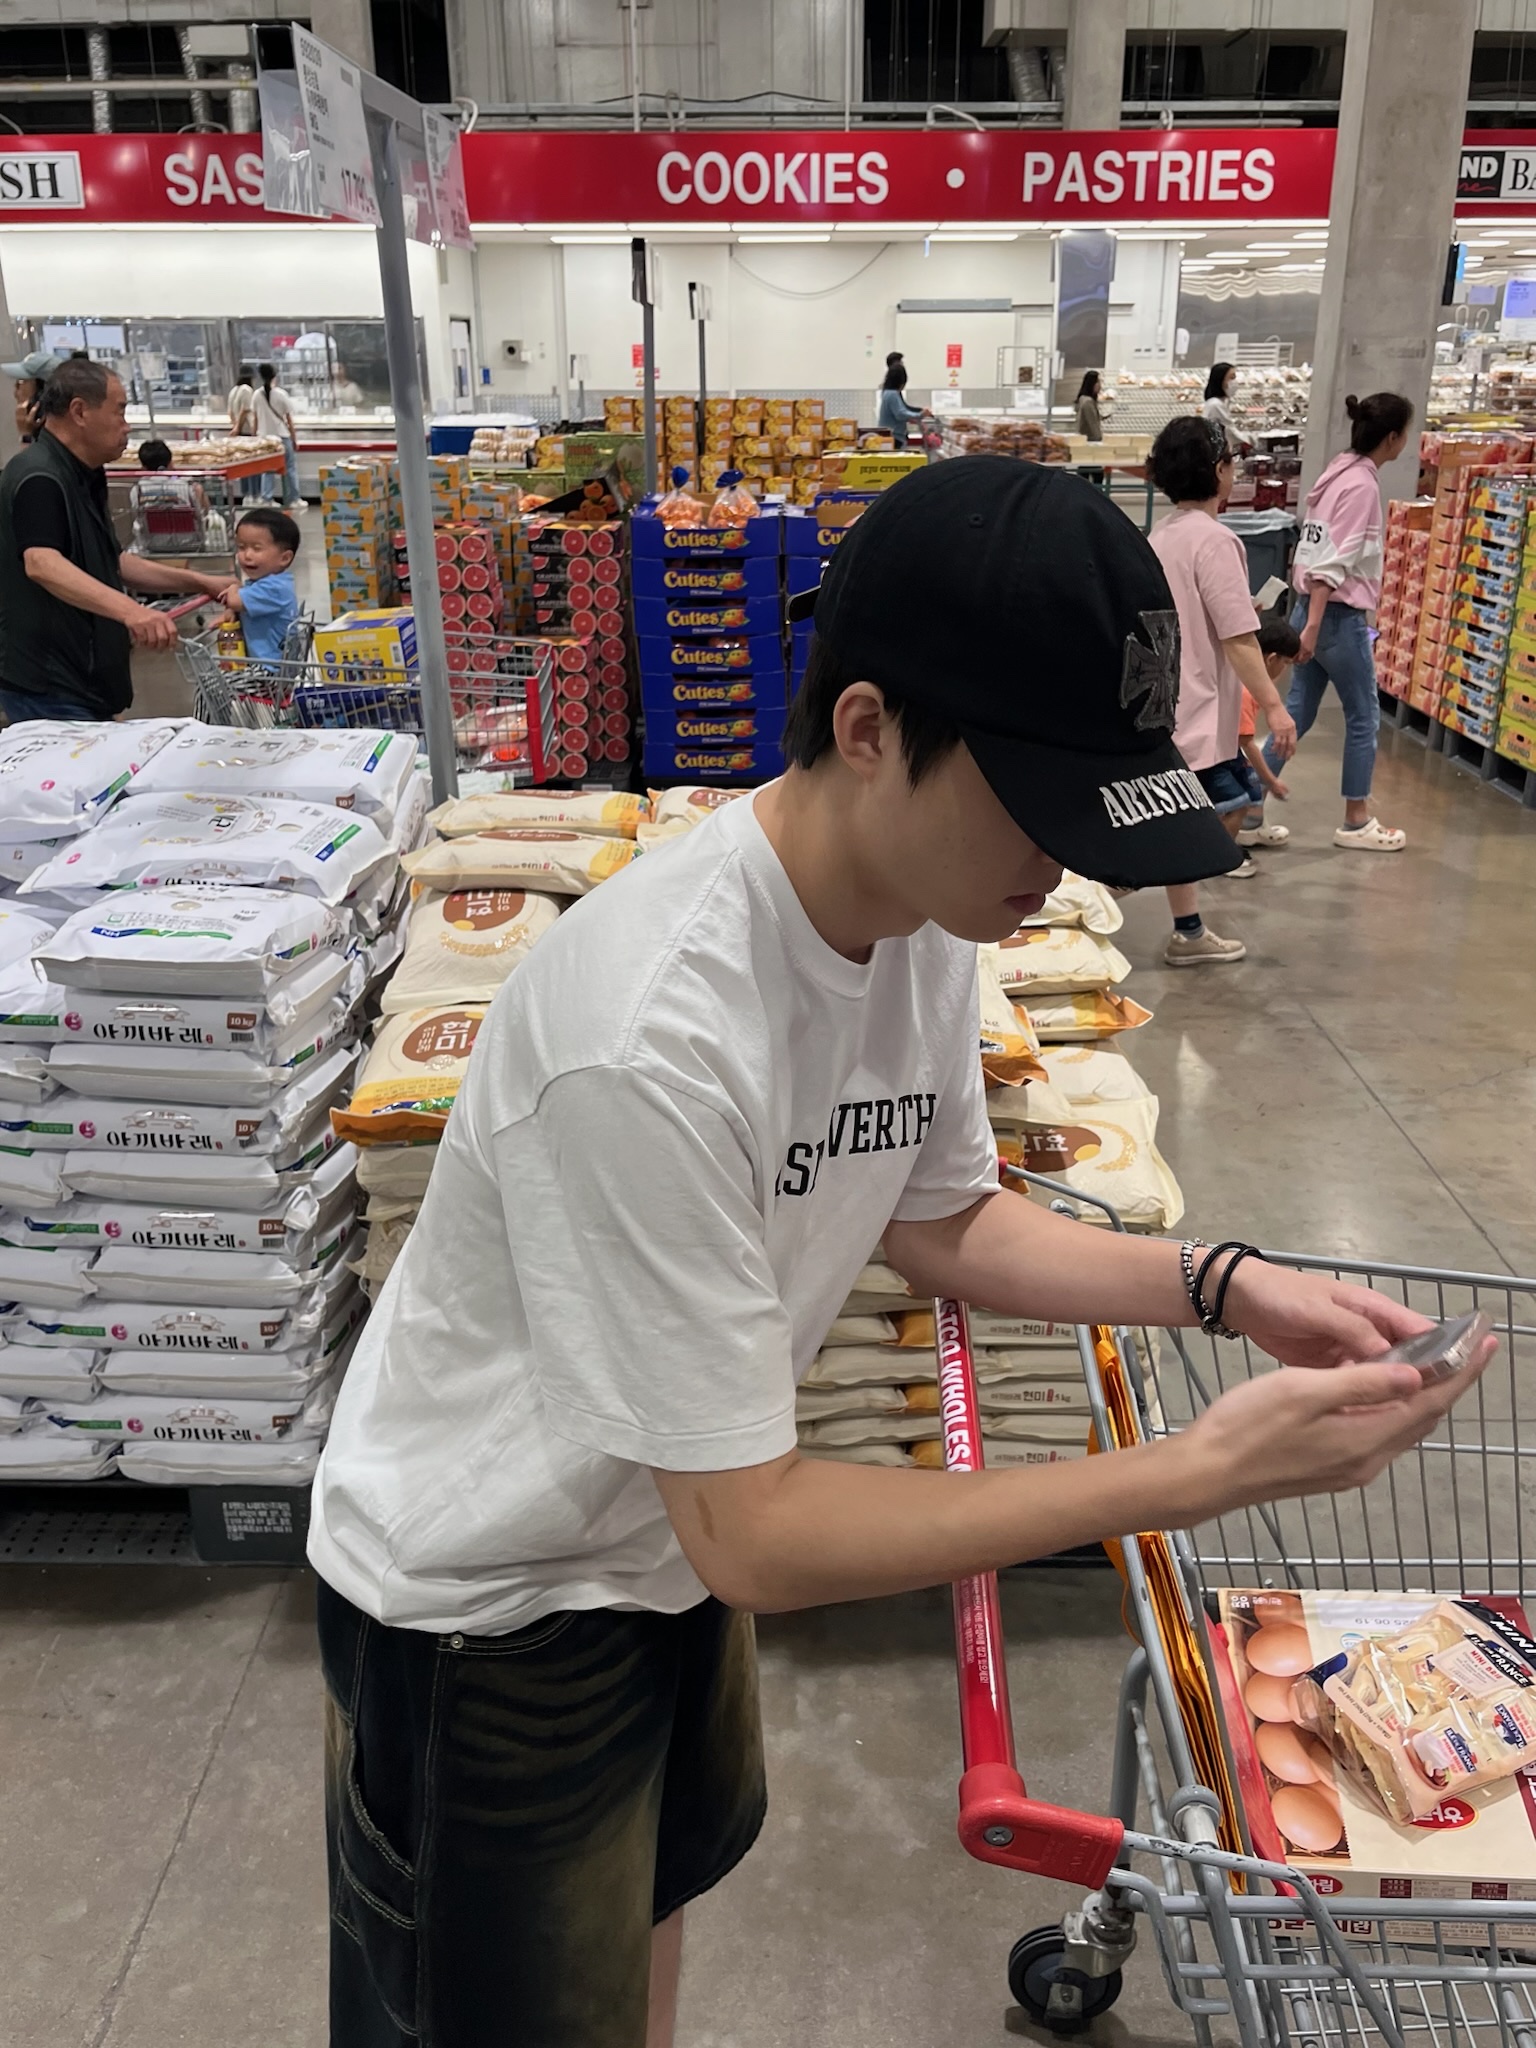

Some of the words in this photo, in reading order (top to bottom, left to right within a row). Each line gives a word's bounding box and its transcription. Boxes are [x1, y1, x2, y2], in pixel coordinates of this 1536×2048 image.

[1022, 148, 1275, 203] PASTRIES
[1460, 156, 1499, 179] ND
[0, 161, 61, 199] SH
[164, 153, 264, 206] SAS
[656, 151, 889, 205] COOKIES
[663, 531, 718, 548] Cuties
[663, 571, 718, 588] Cuties
[666, 610, 719, 627] Cuties
[670, 649, 724, 665] Cuties
[672, 685, 726, 701] Cuties
[676, 721, 729, 737] Cuties
[674, 753, 727, 769] Cuties
[230, 1017, 241, 1026] 10
[93, 1023, 203, 1043] 아끼바레
[238, 1124, 249, 1133] 10
[106, 1131, 213, 1149] 아끼바레
[262, 1223, 272, 1232] 10
[132, 1231, 236, 1248] 아끼바레
[939, 1300, 961, 1358] STCO
[1022, 1324, 1045, 1335] 현미
[138, 1333, 238, 1349] 아끼바레
[1023, 1391, 1046, 1401] 현미
[154, 1426, 251, 1441] 아끼바레
[1026, 1452, 1048, 1463] 현미
[1470, 1650, 1487, 1666] MINI
[1491, 1652, 1530, 1687] FRANCE
